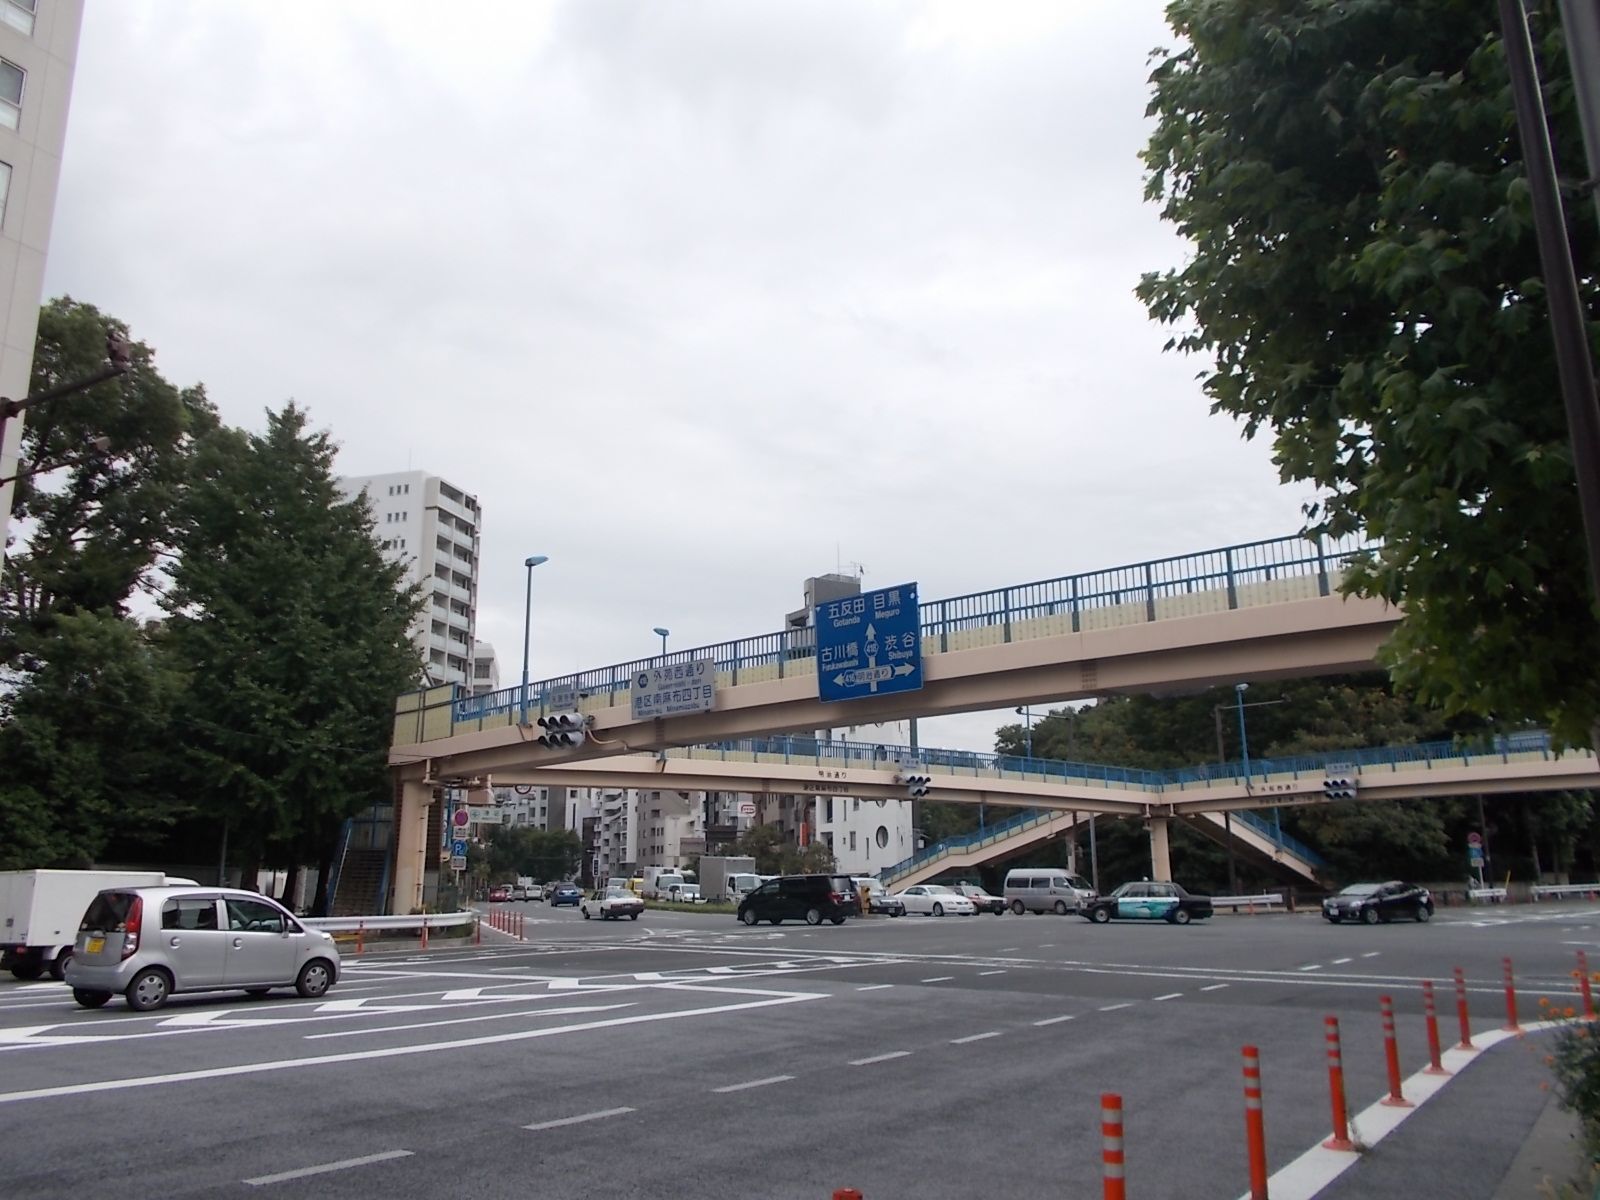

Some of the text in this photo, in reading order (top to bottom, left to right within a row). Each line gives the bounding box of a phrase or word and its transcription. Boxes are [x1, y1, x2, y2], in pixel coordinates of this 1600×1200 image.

[828, 590, 901, 619] 五反田 目黒
[833, 609, 900, 628] Gotanda Meguro
[885, 631, 916, 651] 渋谷
[821, 641, 859, 662] 古川橋
[888, 649, 913, 660] Shibuya
[653, 662, 705, 682] 外苑西通り
[635, 684, 712, 709] 港区南麻布四丁目
[704, 699, 709, 707] 4
